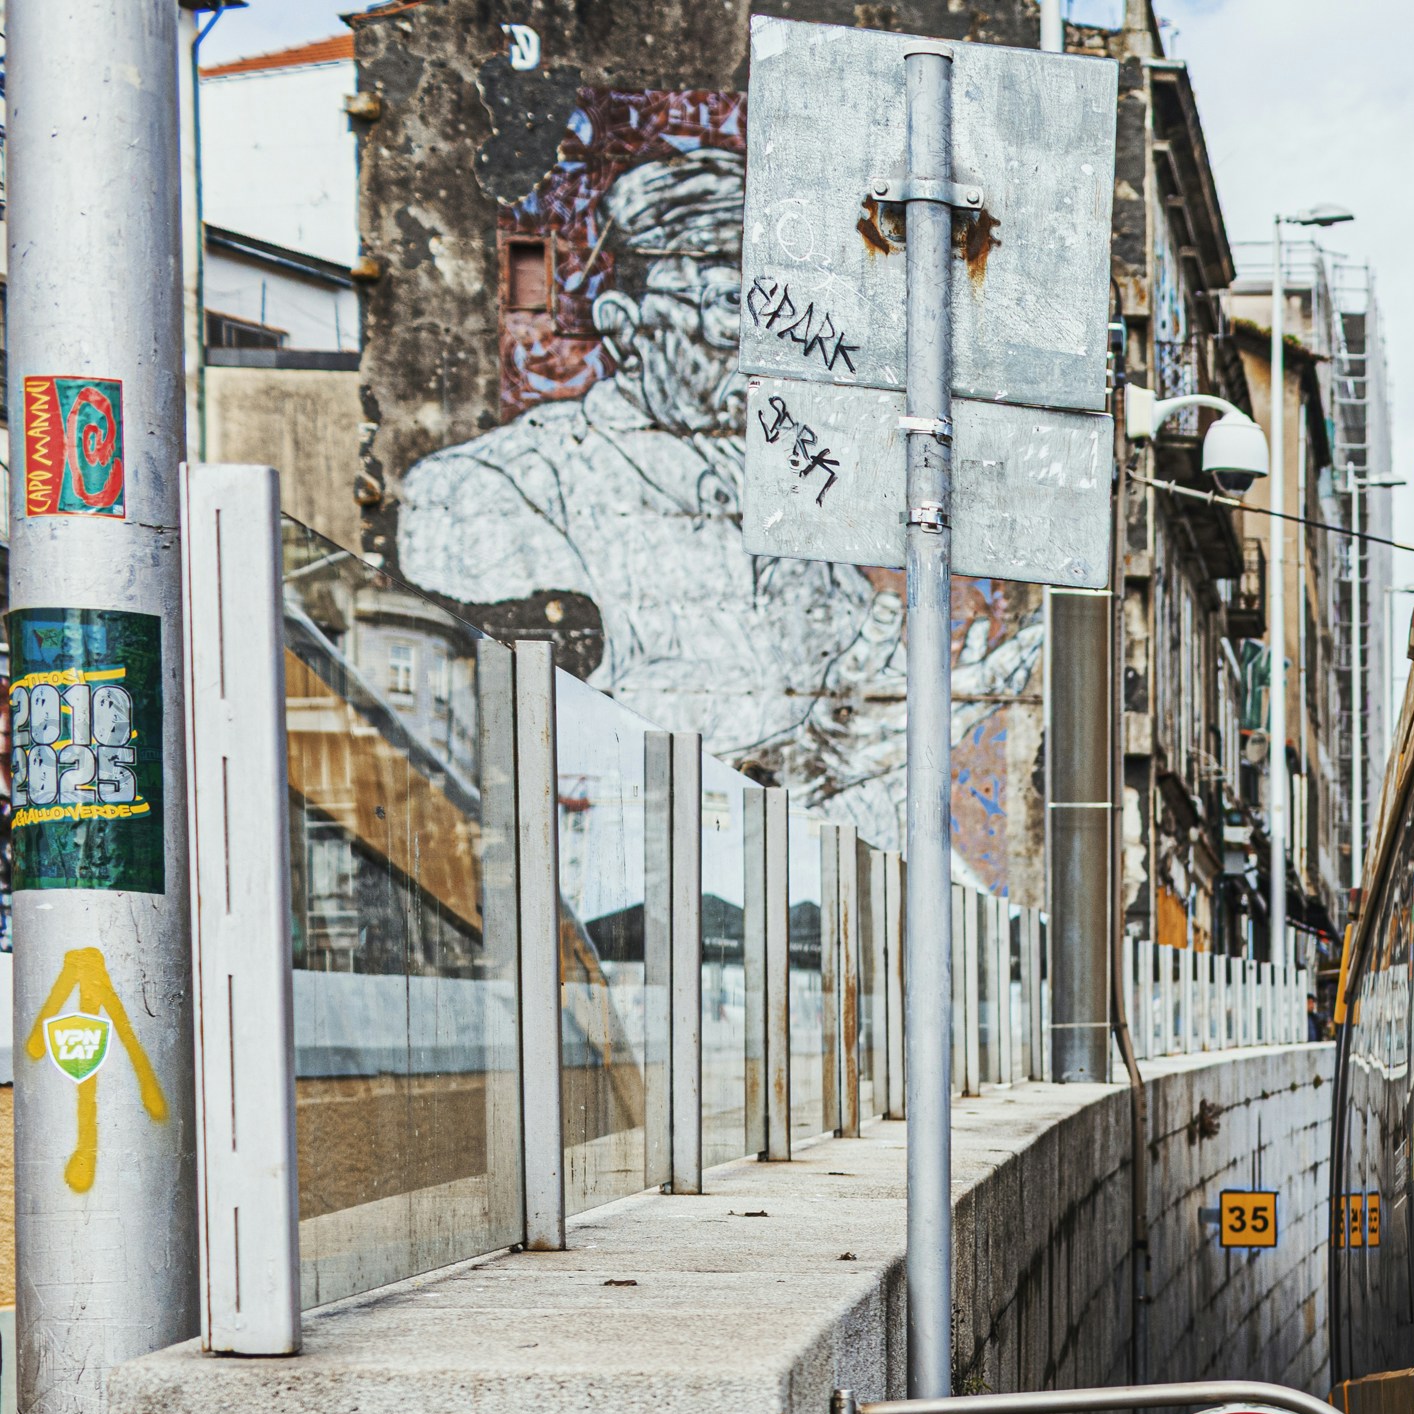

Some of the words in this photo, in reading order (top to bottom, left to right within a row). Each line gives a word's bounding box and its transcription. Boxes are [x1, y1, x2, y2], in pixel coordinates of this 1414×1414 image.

[26, 381, 53, 466] MANNU
[27, 470, 53, 513] CAPO
[9, 683, 134, 746] 2010
[9, 744, 137, 807] 2025
[54, 1029, 102, 1045] VPN
[59, 1045, 99, 1059] LAT
[1228, 1206, 1269, 1233] 35
